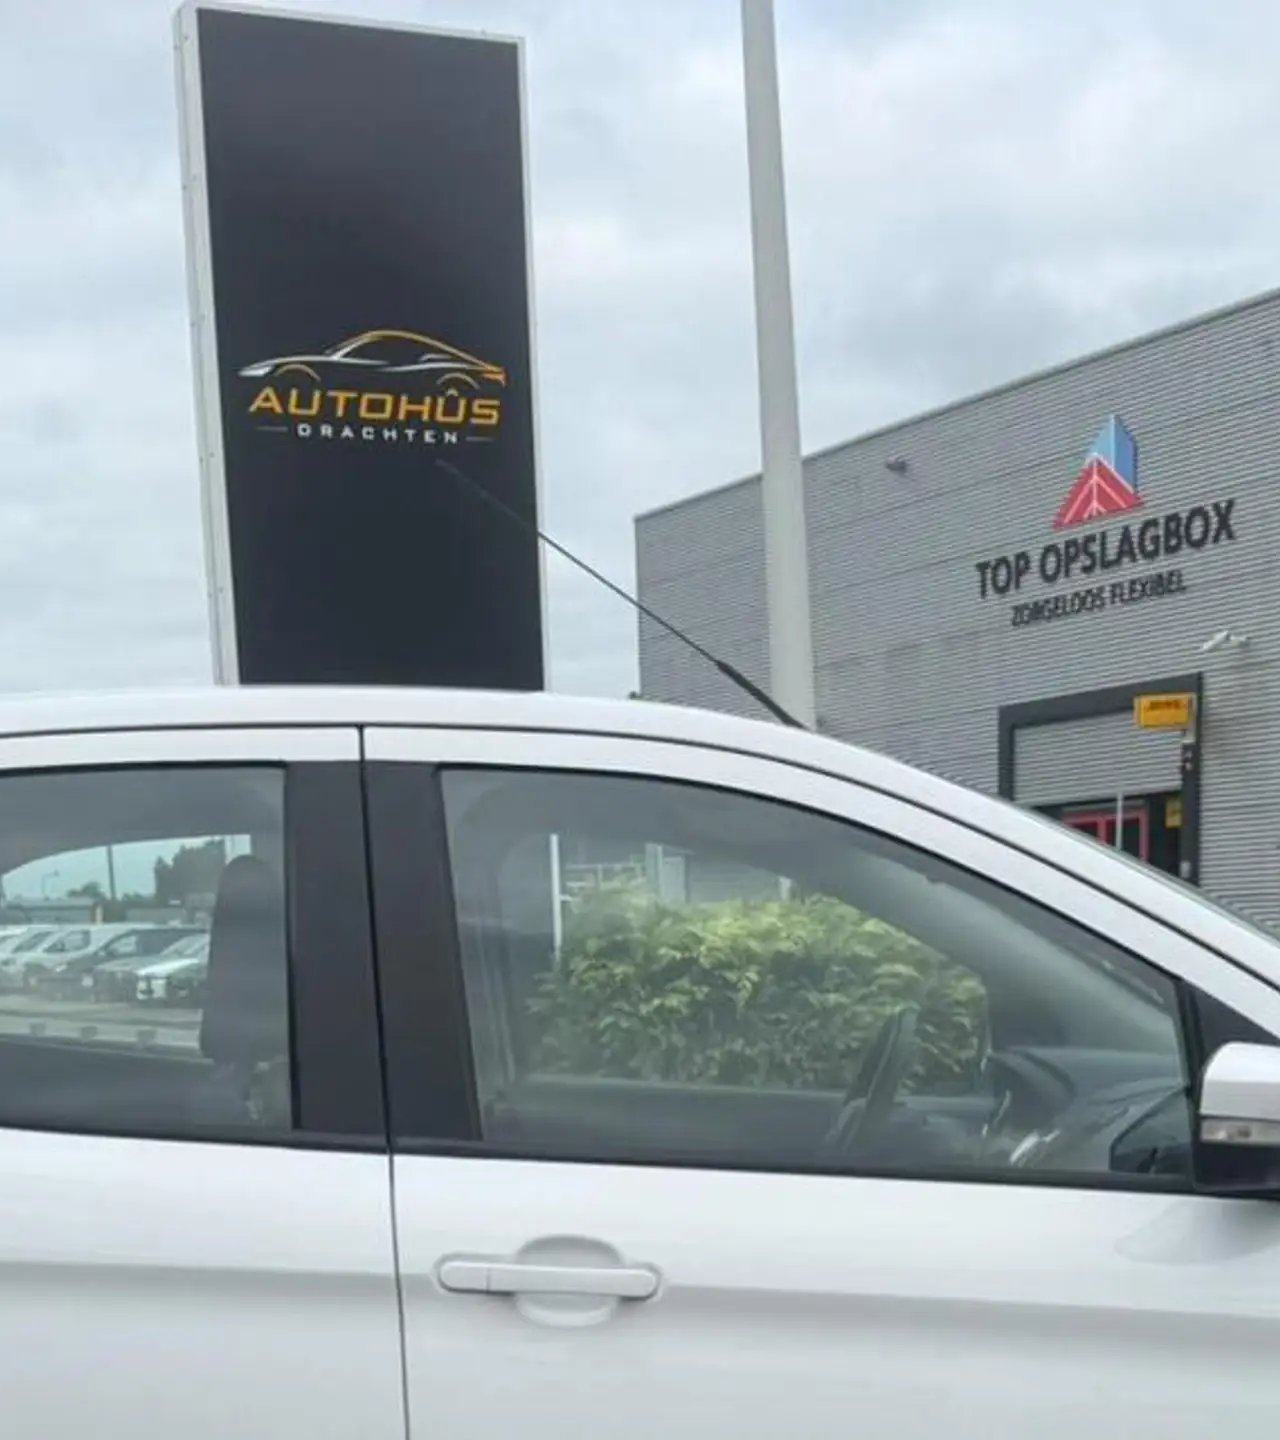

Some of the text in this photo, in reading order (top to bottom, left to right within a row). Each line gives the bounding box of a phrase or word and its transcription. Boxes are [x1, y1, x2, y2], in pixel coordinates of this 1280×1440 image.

[249, 386, 500, 425] AUTOHÛS
[297, 423, 458, 444] DRACHTEN
[976, 500, 1235, 599] TOP OPSLAGBOX
